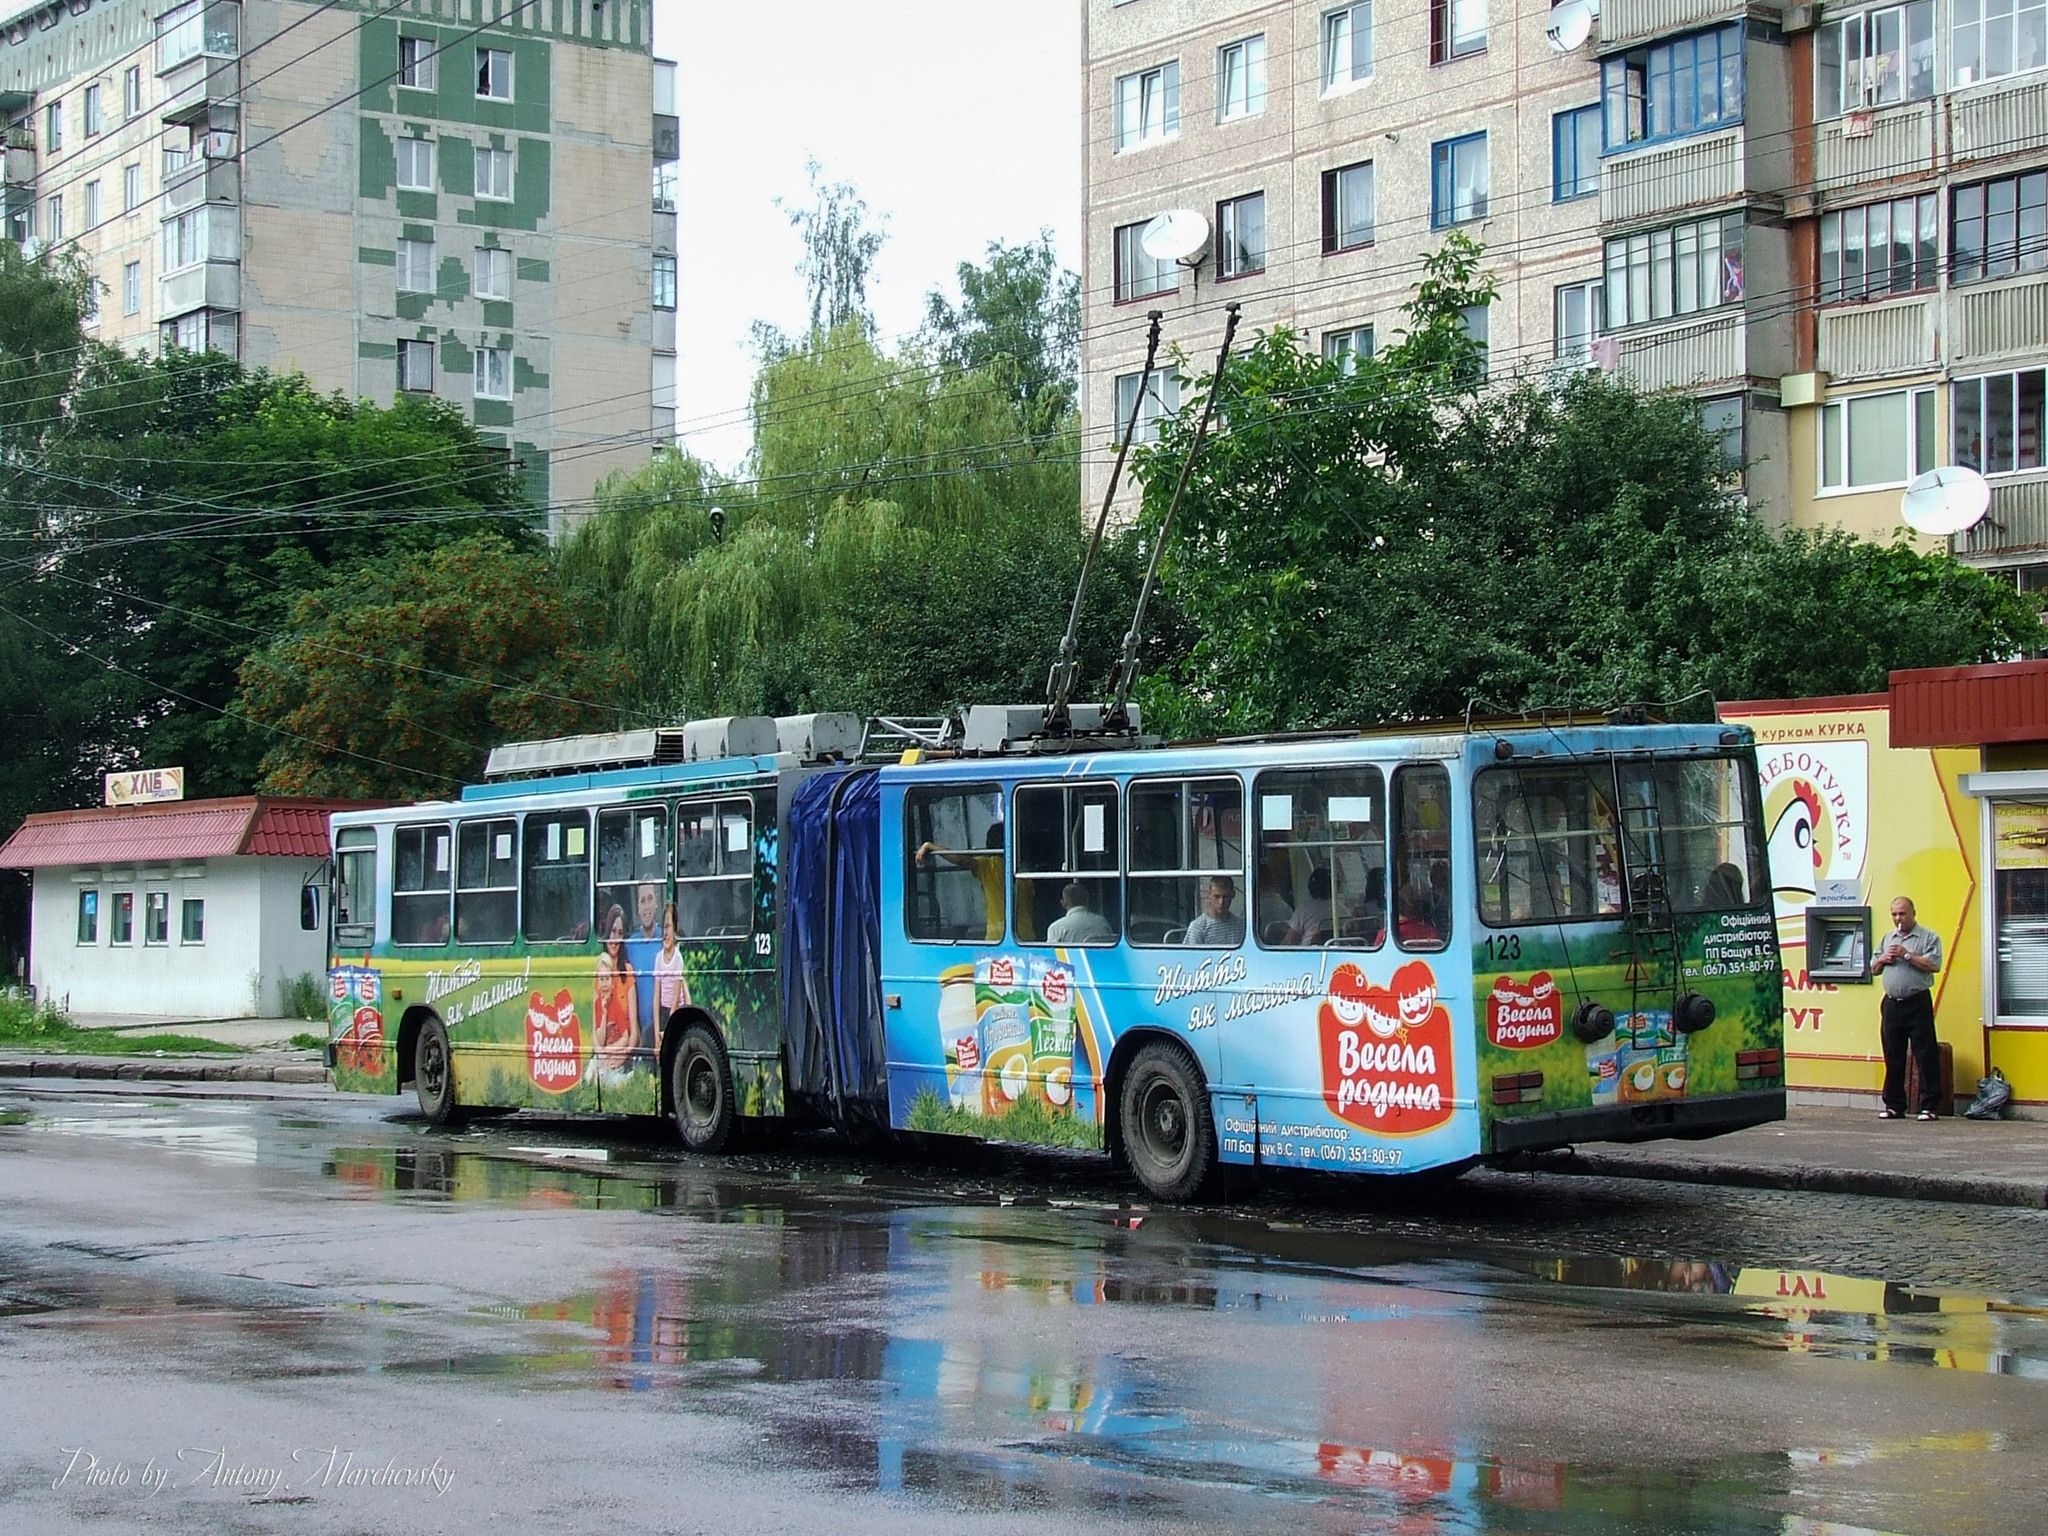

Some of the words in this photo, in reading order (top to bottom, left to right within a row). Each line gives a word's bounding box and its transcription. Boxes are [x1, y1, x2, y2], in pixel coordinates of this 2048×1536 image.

[1762, 728, 1814, 741] куркам
[1818, 722, 1866, 736] КУРКА
[131, 772, 162, 795] ХЛІБ
[1720, 912, 1772, 928] Офіційний
[755, 933, 771, 954] 123
[1485, 934, 1520, 960] 123
[1705, 947, 1720, 959] ПП
[1721, 946, 1754, 958] Бащук
[1754, 944, 1774, 956] В.С.
[1155, 951, 1247, 1005] Життя
[1702, 963, 1727, 976] (067)
[1728, 960, 1775, 974] 351-80-97
[426, 957, 481, 1004] Життя
[445, 1002, 464, 1026] як
[468, 956, 531, 1017] малина!
[1188, 1001, 1216, 1031] як
[1225, 951, 1328, 1021] малина!
[1497, 1004, 1553, 1026] Весела
[1783, 1007, 1824, 1031] УТ
[533, 1031, 574, 1058] Весела
[1496, 1022, 1555, 1043] родина
[1338, 1030, 1436, 1076] Весела
[533, 1058, 576, 1082] родина
[1338, 1078, 1441, 1118] родина
[1224, 1118, 1277, 1134] Офіційний
[1224, 1138, 1238, 1152] ПП
[1277, 1143, 1297, 1157] В.С.
[1300, 1146, 1320, 1158] тел.
[1320, 1145, 1346, 1161] (067)
[1348, 1147, 1403, 1165] 351-80-97
